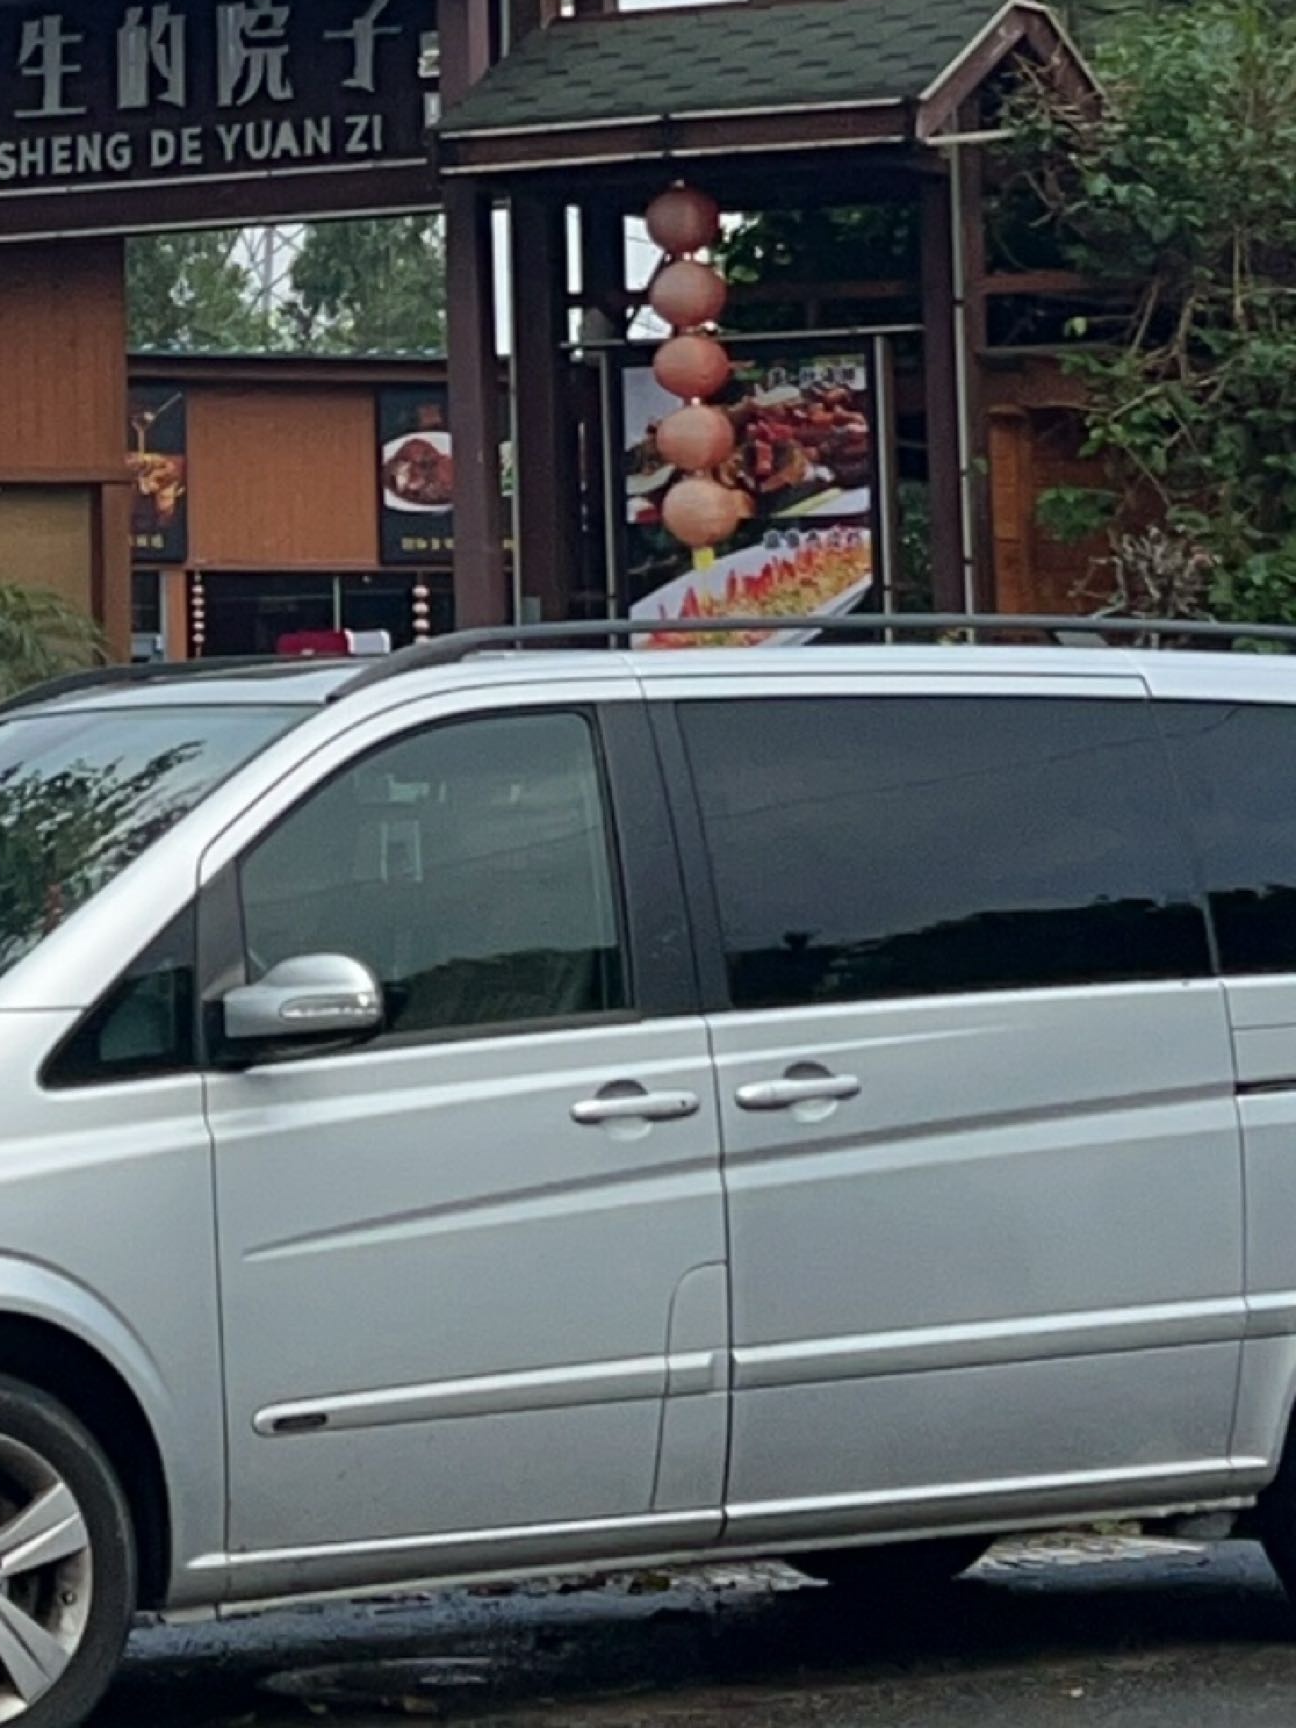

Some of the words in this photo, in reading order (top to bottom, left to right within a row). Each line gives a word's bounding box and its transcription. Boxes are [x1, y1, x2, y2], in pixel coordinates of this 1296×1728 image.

[150, 127, 203, 167] DE
[217, 116, 332, 163] YUAN
[345, 114, 383, 154] ZI
